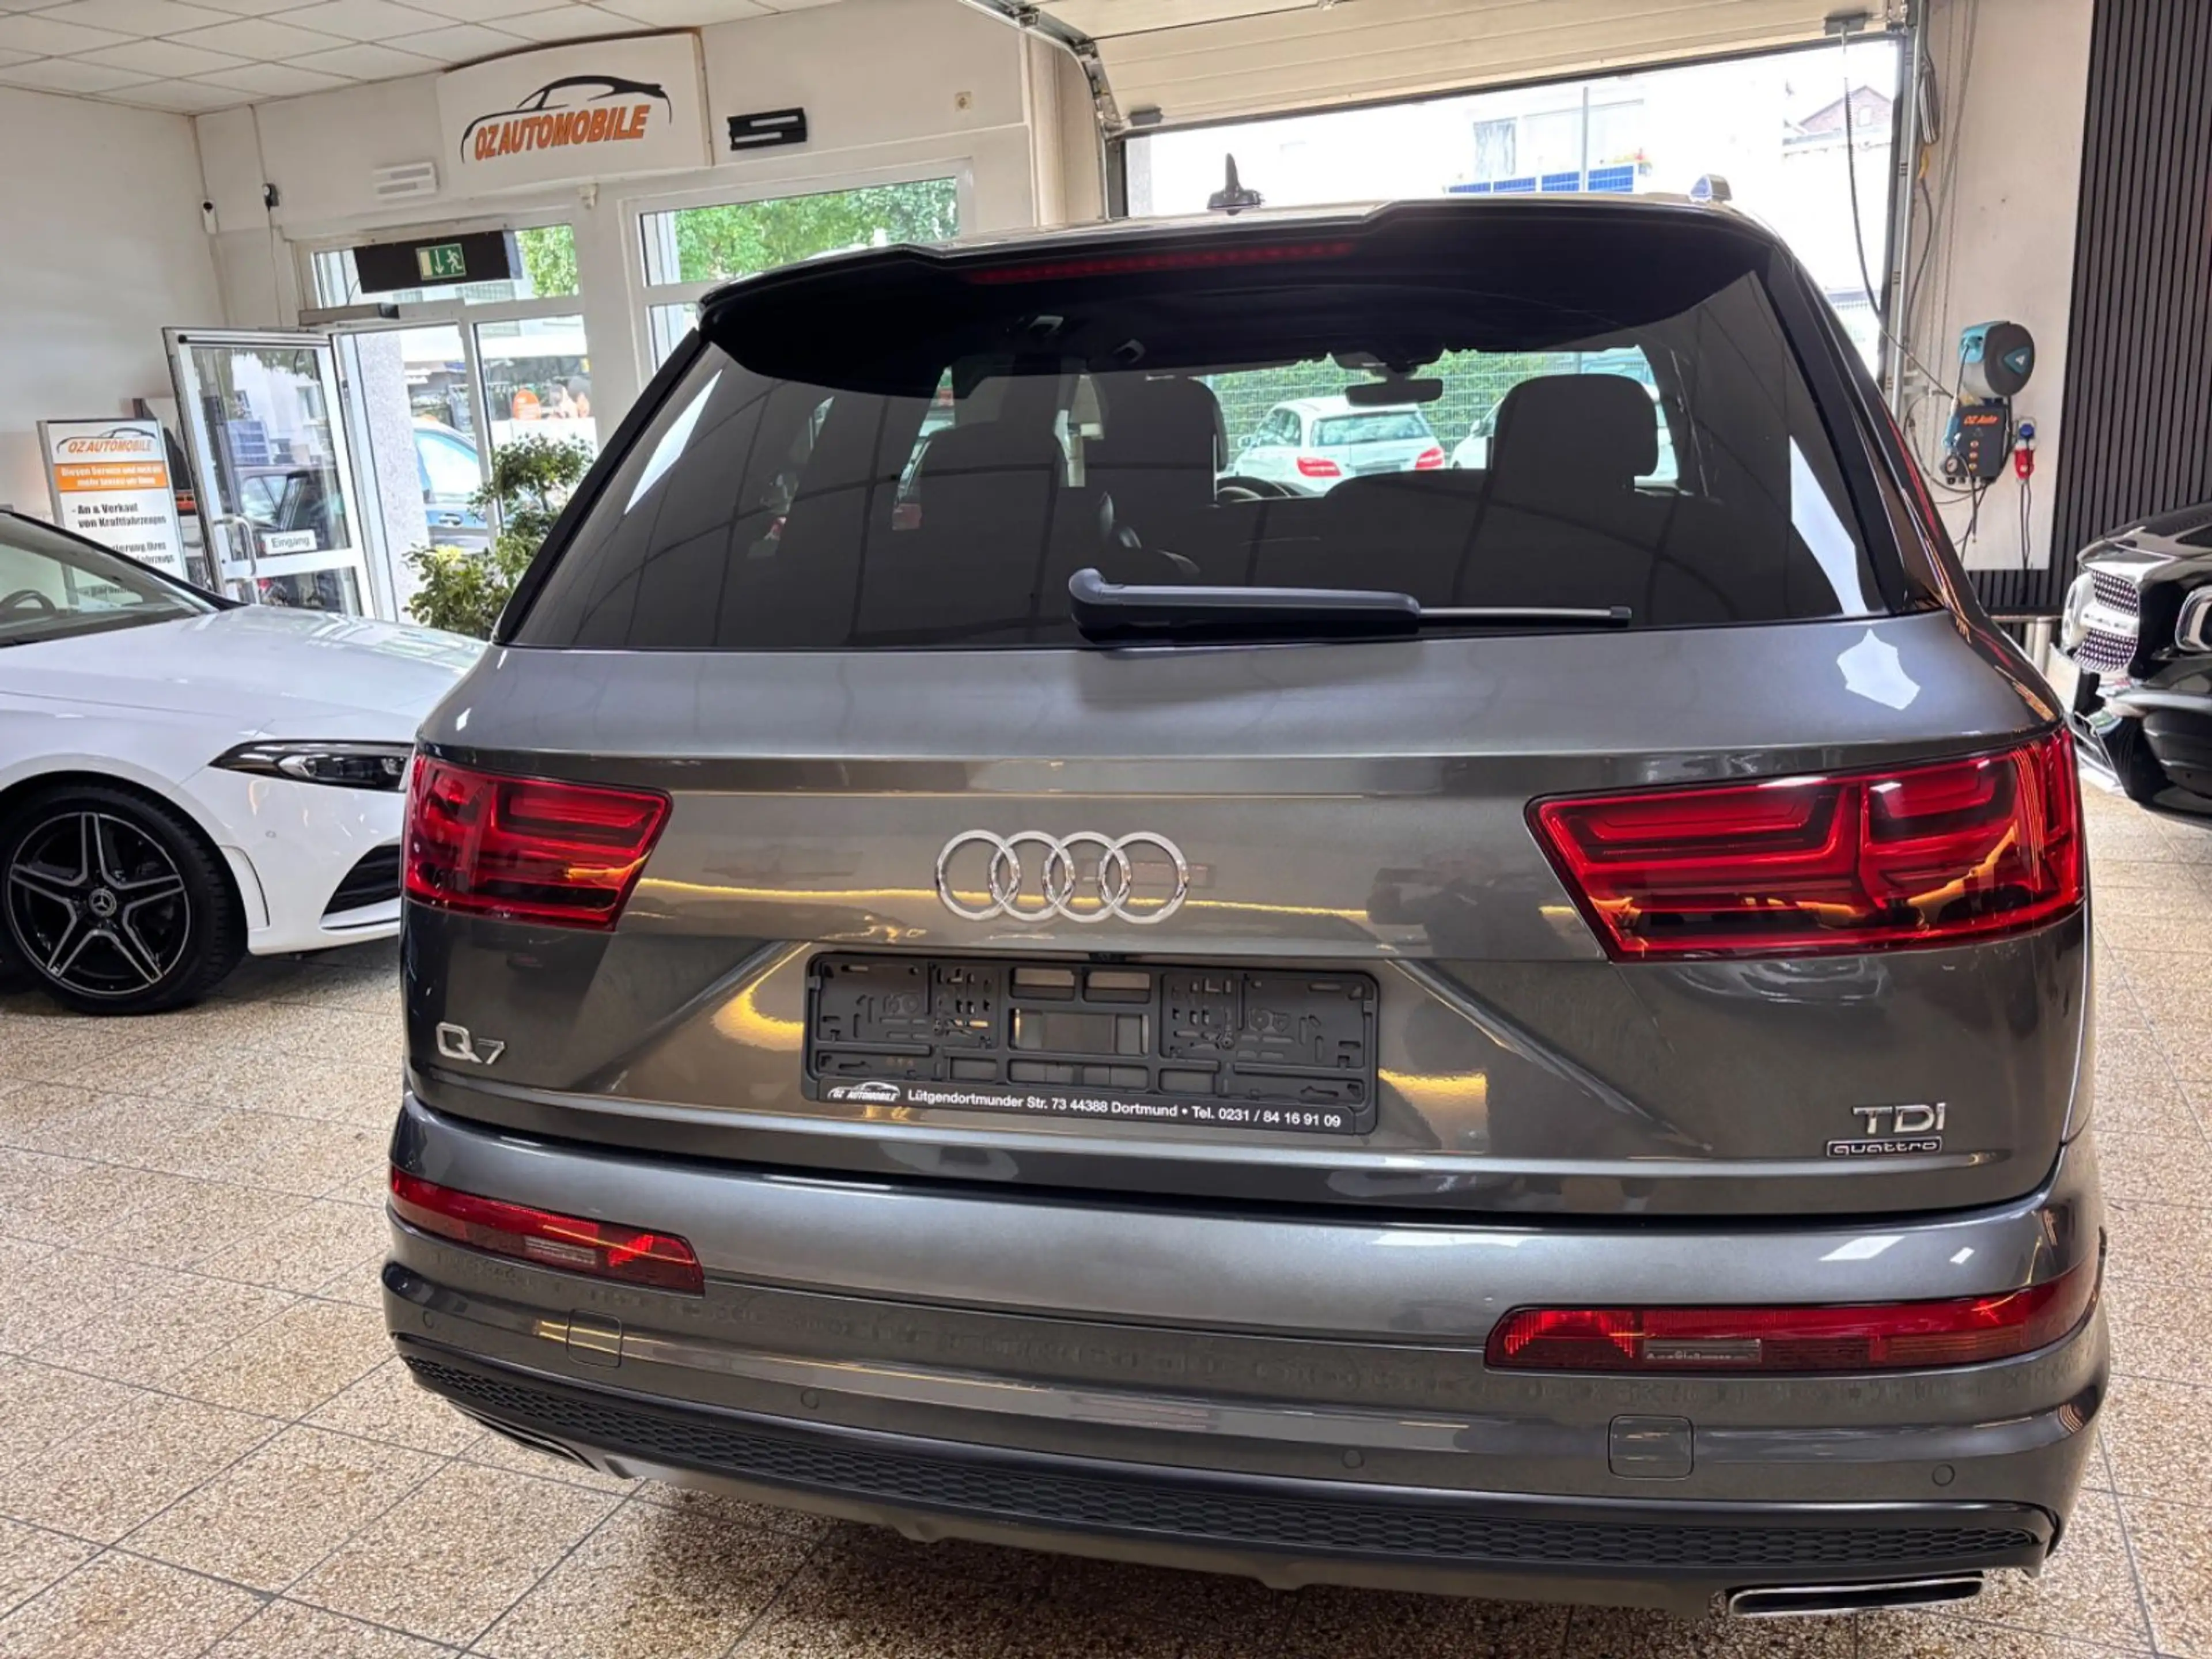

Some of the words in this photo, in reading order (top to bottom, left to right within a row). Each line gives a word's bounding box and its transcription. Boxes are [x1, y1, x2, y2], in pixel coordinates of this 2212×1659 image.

[77, 505, 91, 514] An
[101, 503, 138, 513] Verkauf
[78, 520, 97, 528] von
[99, 515, 166, 528] Kraftfahrzeugen
[271, 536, 310, 548] Eingang
[436, 1021, 505, 1065] Q7
[908, 1089, 1023, 1108] Lütgendortmunder
[1027, 1097, 1048, 1109] Str.
[1051, 1098, 1067, 1111] 73
[1070, 1100, 1108, 1113] 44388
[1112, 1101, 1177, 1117] Dortmund
[1192, 1105, 1215, 1119] Tel.
[1218, 1107, 1250, 1122] 0231
[1263, 1109, 1280, 1123] 84
[1285, 1111, 1300, 1124] 16
[1303, 1112, 1319, 1126] 91
[1324, 1113, 1342, 1127] 09
[1852, 1101, 1946, 1134] TDI
[1834, 1141, 1938, 1157] quattro
